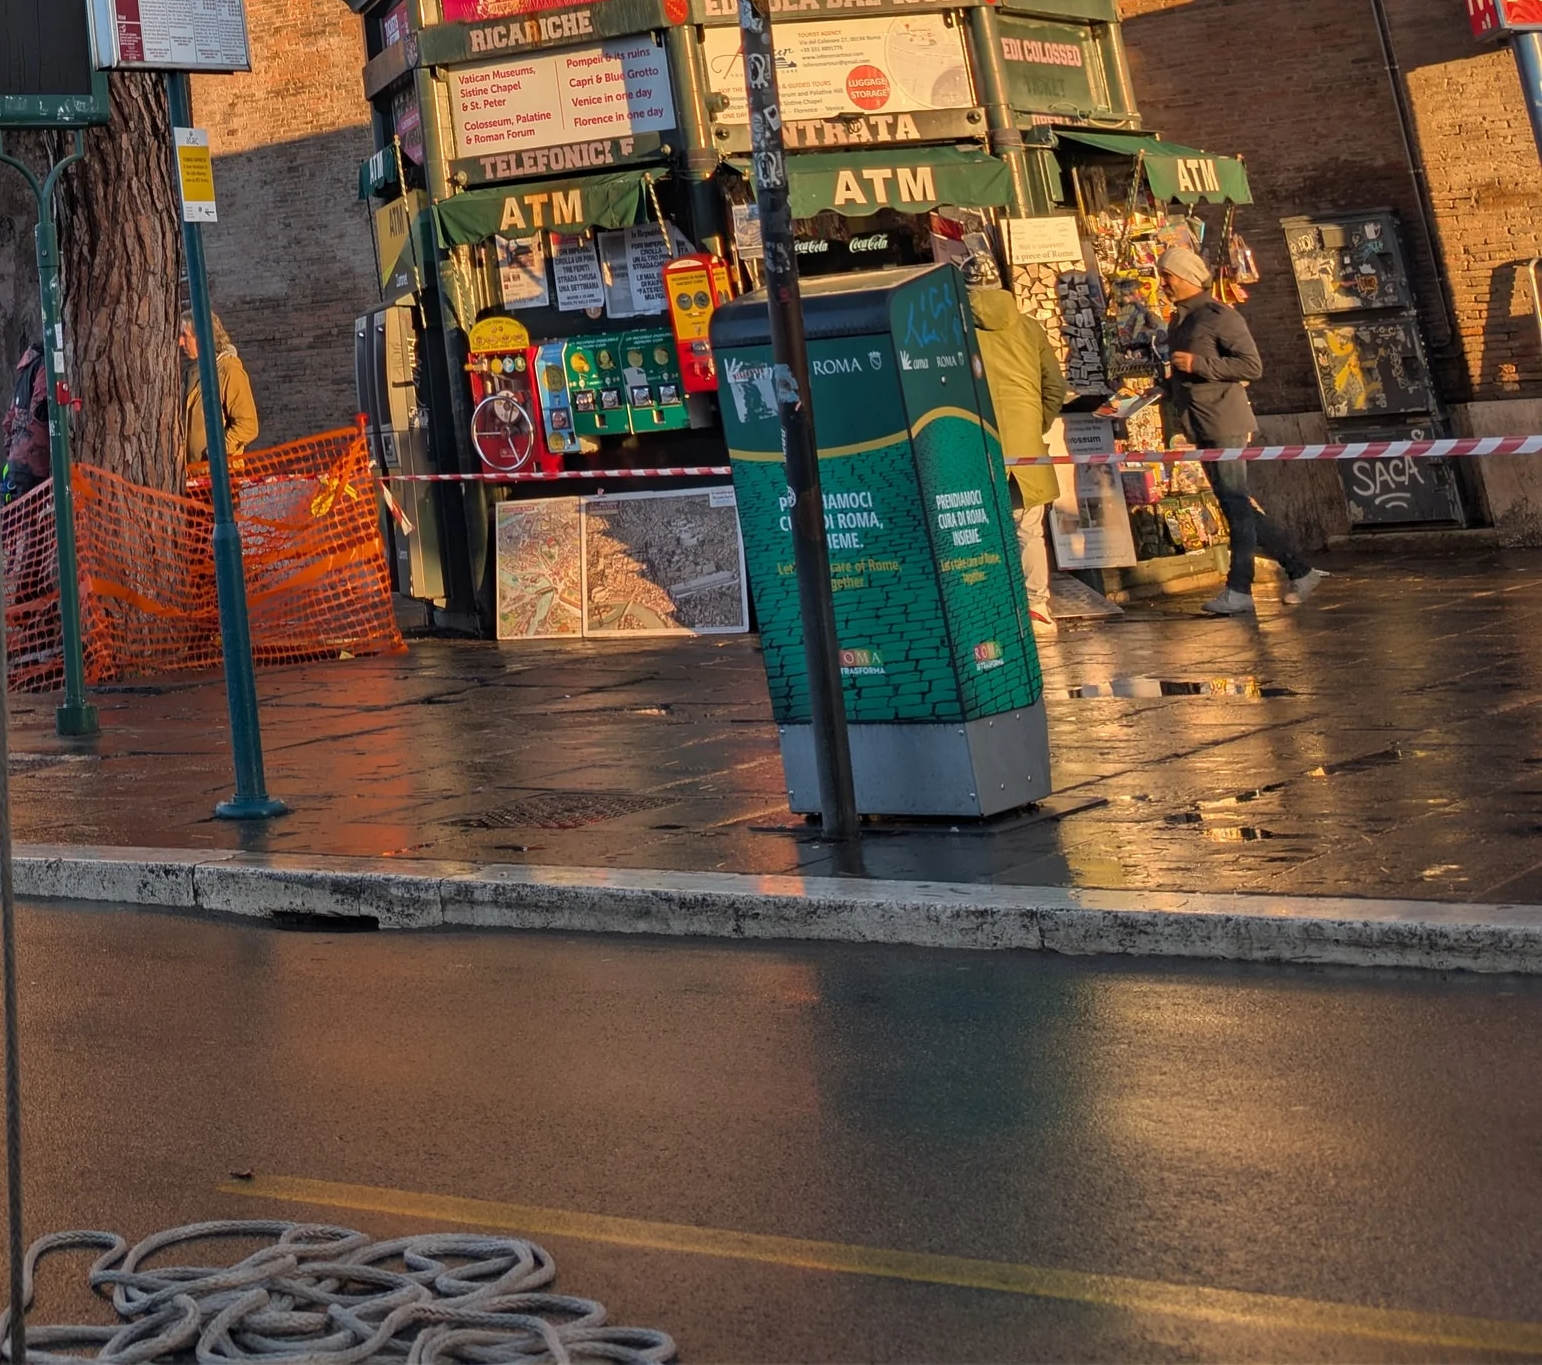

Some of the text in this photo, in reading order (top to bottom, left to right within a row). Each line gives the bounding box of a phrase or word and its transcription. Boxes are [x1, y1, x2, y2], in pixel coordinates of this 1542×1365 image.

[469, 9, 594, 52] RICARICHE
[566, 47, 651, 68] Pompeii & its ruins
[1001, 37, 1082, 67] EDI COLOSSEO
[458, 65, 536, 86] Vatican Museums,
[569, 66, 659, 89] Capri & Blue Grotto
[848, 77, 887, 87] LUGGAGE
[459, 80, 521, 99] Sistine Chapel
[571, 87, 653, 108] Venice in one day
[851, 89, 888, 99] STORAGE
[461, 97, 506, 112] & St. Peter
[464, 111, 552, 132] Colosseum, Palatine
[573, 106, 665, 127] Florence in one day
[465, 127, 536, 145] & Roman Forum
[758, 114, 922, 149] NTRATA
[369, 149, 384, 185] ATM
[1176, 158, 1220, 192] ATM
[833, 166, 937, 206] ATM
[500, 189, 583, 232] ATM
[388, 204, 405, 238] ATM
[555, 256, 575, 265] CROLLA
[640, 248, 662, 256] CROLLA
[1021, 252, 1041, 261] piece
[1052, 250, 1074, 258] Rome
[557, 275, 577, 284] STRADA
[813, 357, 862, 376] ROMA
[912, 353, 957, 370] ama ROMA
[779, 491, 872, 512] PIAMOCI
[935, 489, 983, 510] PRENDIAMOCI
[837, 511, 884, 530] ROMA,
[938, 508, 989, 529] CURA DI ROMA,
[827, 533, 864, 550] IEME.
[952, 528, 982, 546] INSIEME.
[777, 561, 796, 576] Let'
[855, 559, 866, 571] of
[830, 575, 864, 593] gether
[843, 651, 882, 664] OMA
[974, 644, 1002, 661] ROMA
[840, 667, 886, 675] TRASFORMA
